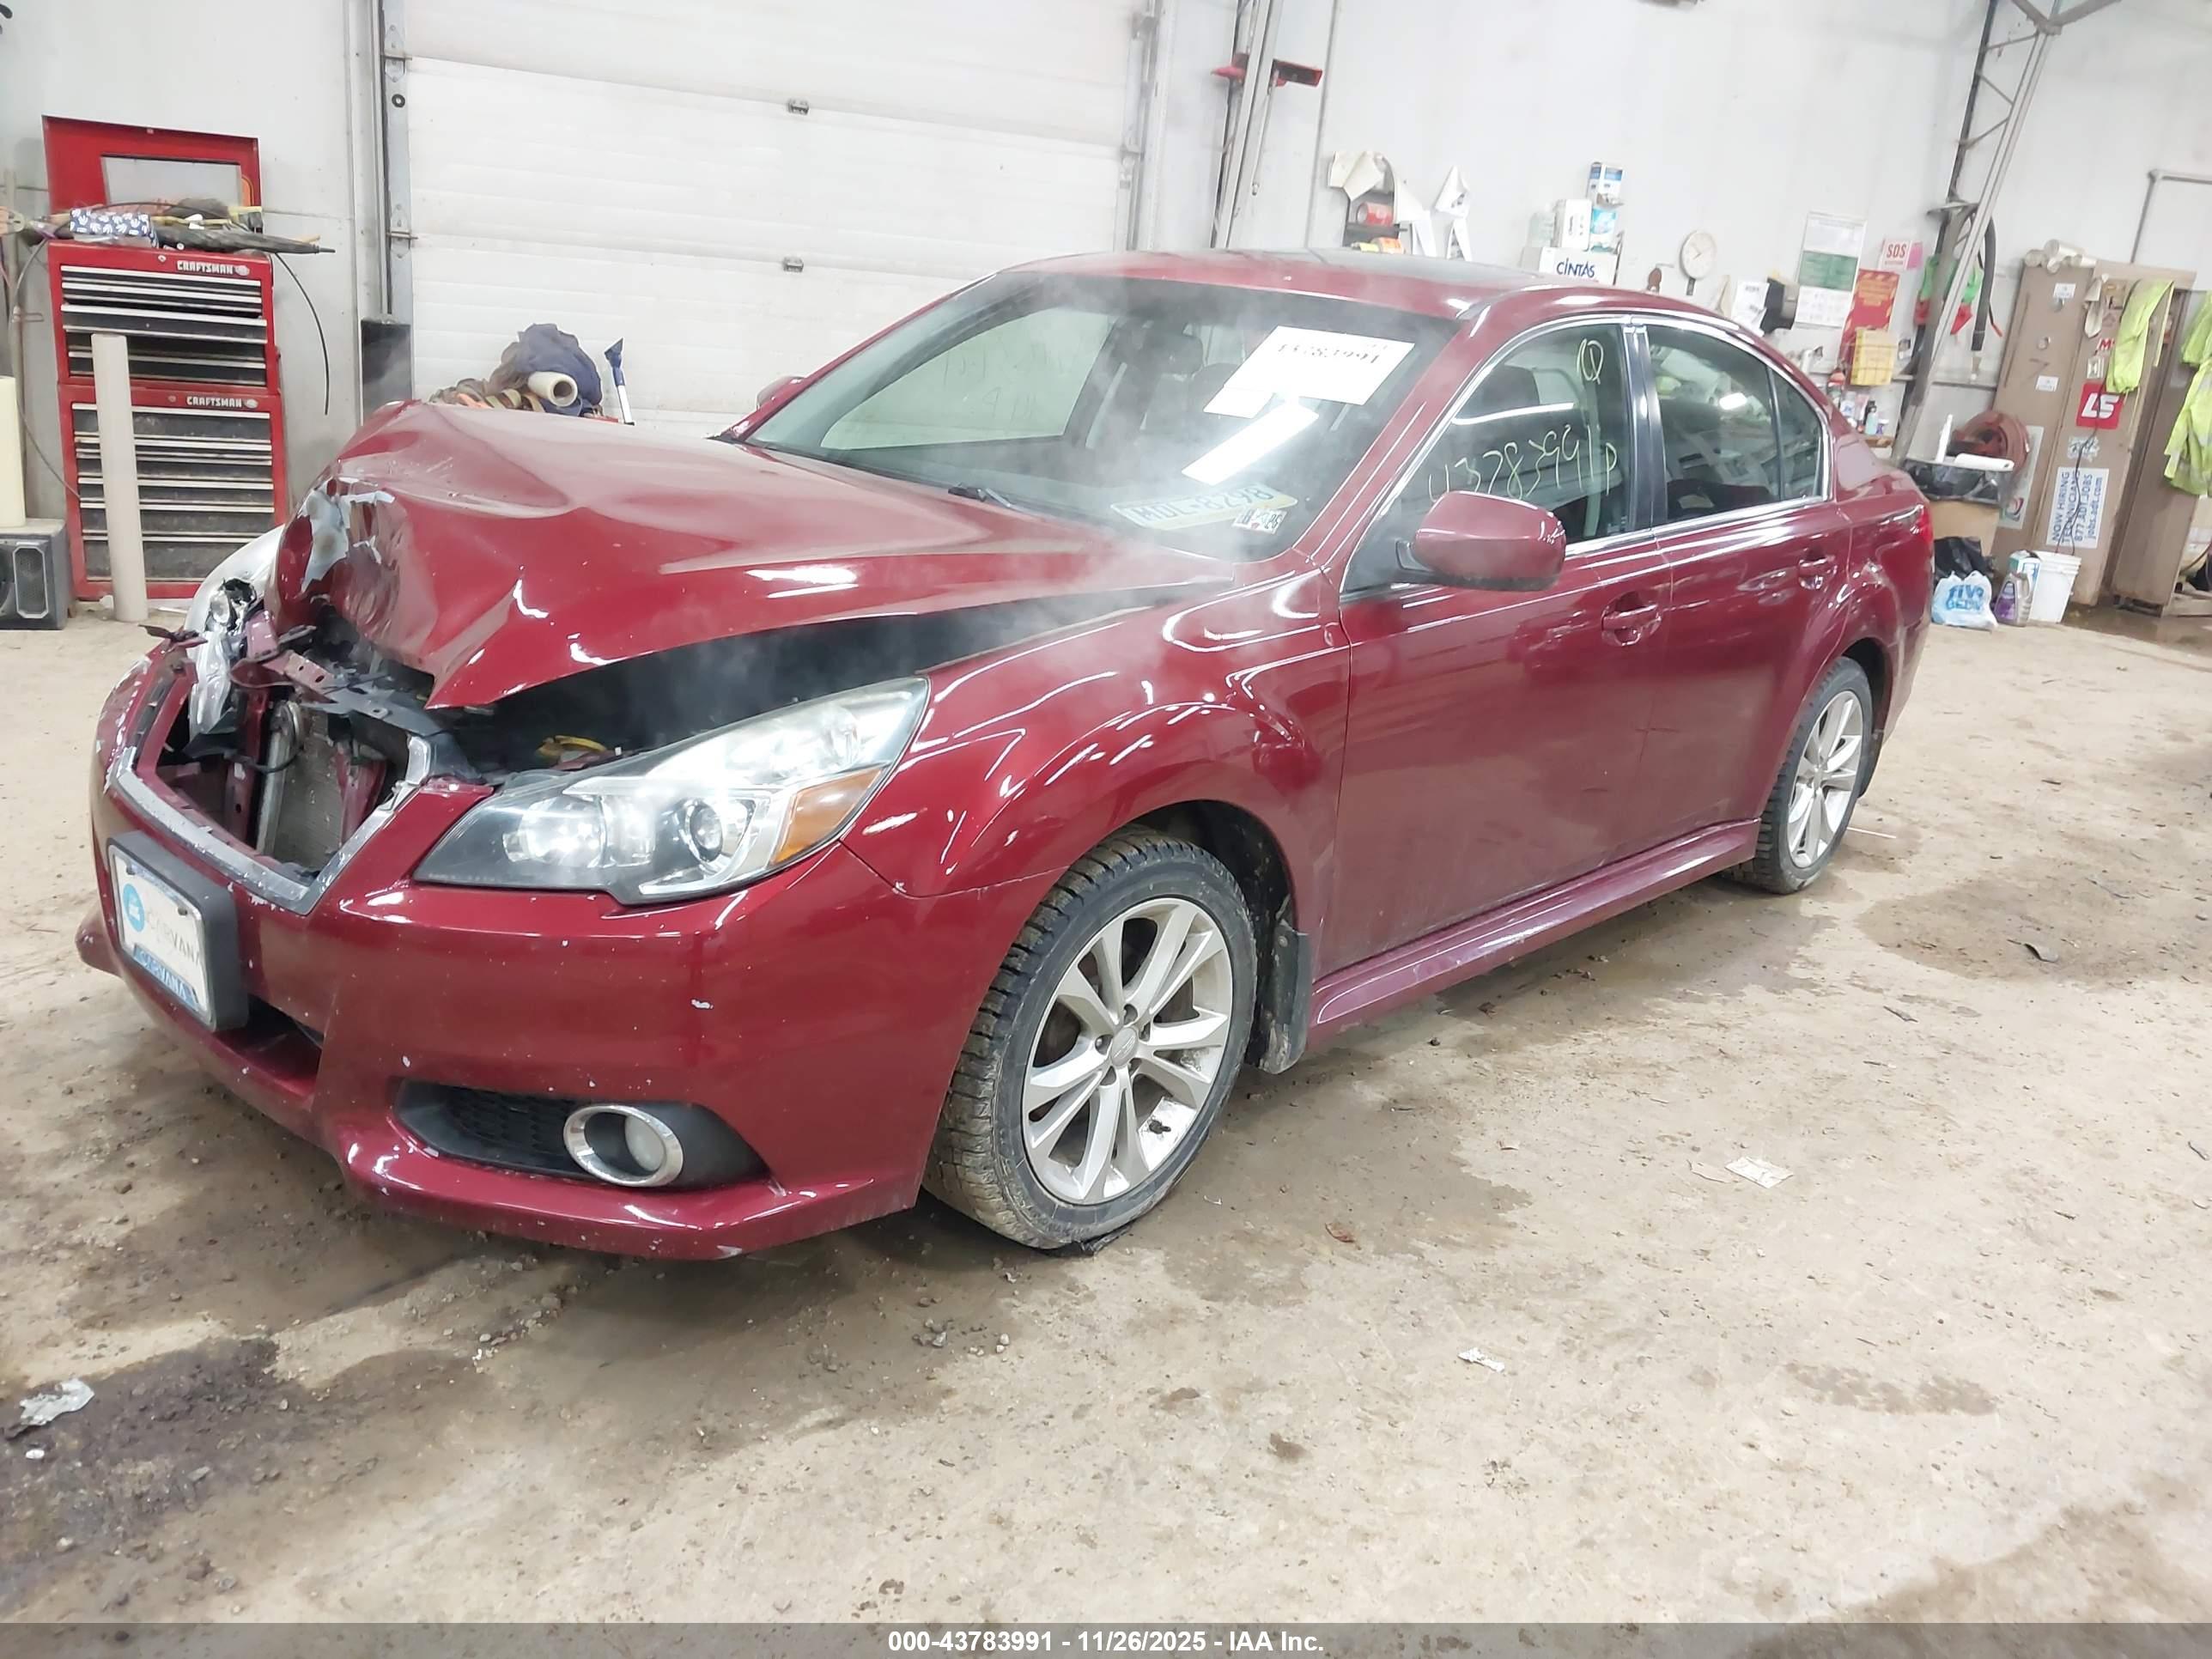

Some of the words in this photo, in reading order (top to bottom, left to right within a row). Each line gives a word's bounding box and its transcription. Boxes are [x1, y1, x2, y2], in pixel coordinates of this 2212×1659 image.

[177, 260, 234, 275] CRAFTSMAN
[1556, 258, 1595, 278] CINTAS
[186, 396, 242, 408] CRAFTSMAN
[2057, 471, 2070, 510] HIRING
[2084, 477, 2103, 540] jobs.adt.com
[2052, 514, 2063, 541] NOW
